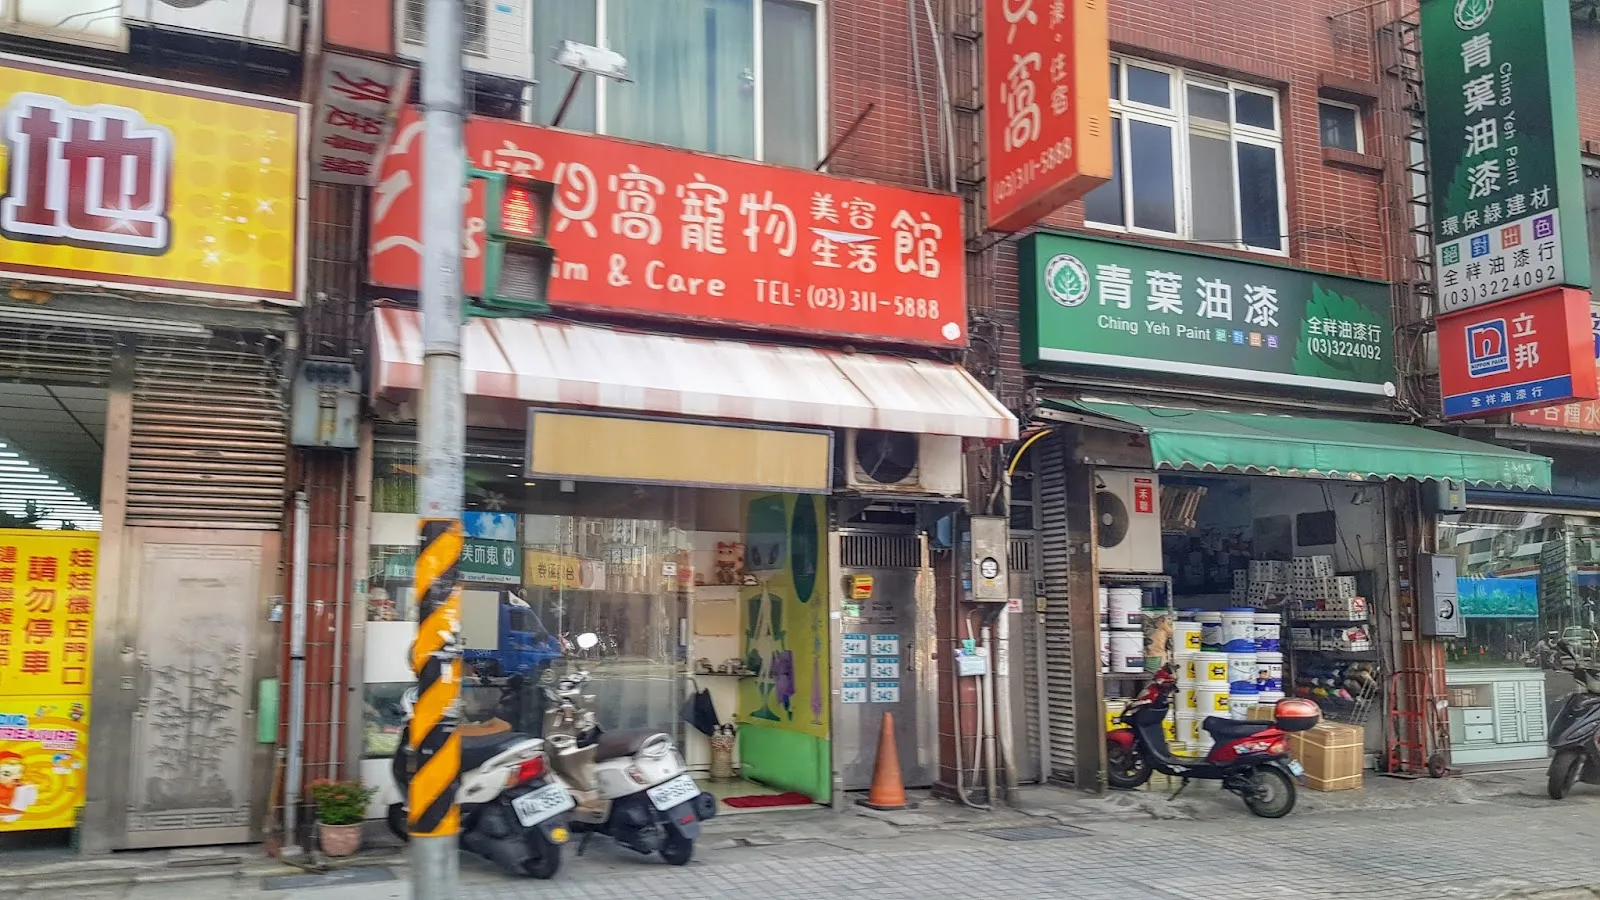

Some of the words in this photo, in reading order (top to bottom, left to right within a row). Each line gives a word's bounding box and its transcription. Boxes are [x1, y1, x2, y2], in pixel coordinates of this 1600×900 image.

[1499, 62, 1512, 107] Ching
[1460, 32, 1501, 199] 青葉油漆
[1503, 110, 1517, 140] Yeh
[8, 98, 166, 250] 地
[1505, 146, 1519, 186] Paint
[809, 191, 877, 230] 美容
[1441, 184, 1551, 236] 環保綠建材
[810, 238, 878, 274] 生活
[890, 209, 942, 279] 館
[1443, 217, 1553, 266] 絕對出色
[607, 253, 632, 287] &
[645, 260, 726, 298] Care
[1443, 241, 1555, 288] 全祥油漆行
[1095, 264, 1279, 327] 青葉油漆
[1443, 265, 1556, 311] (03)3224092
[1097, 315, 1138, 335] Ching
[1145, 320, 1170, 336] Yeh
[1176, 324, 1211, 341] Paint
[1307, 316, 1382, 343] 全祥油漆行
[1307, 337, 1382, 360] (03)3224092
[1512, 312, 1540, 370] 立邦
[1470, 360, 1490, 370] NIPPON
[1470, 386, 1543, 408] 全祥油漆行
[21, 556, 57, 675] 請勿停車
[62, 548, 94, 685] 娃娃機店門口
